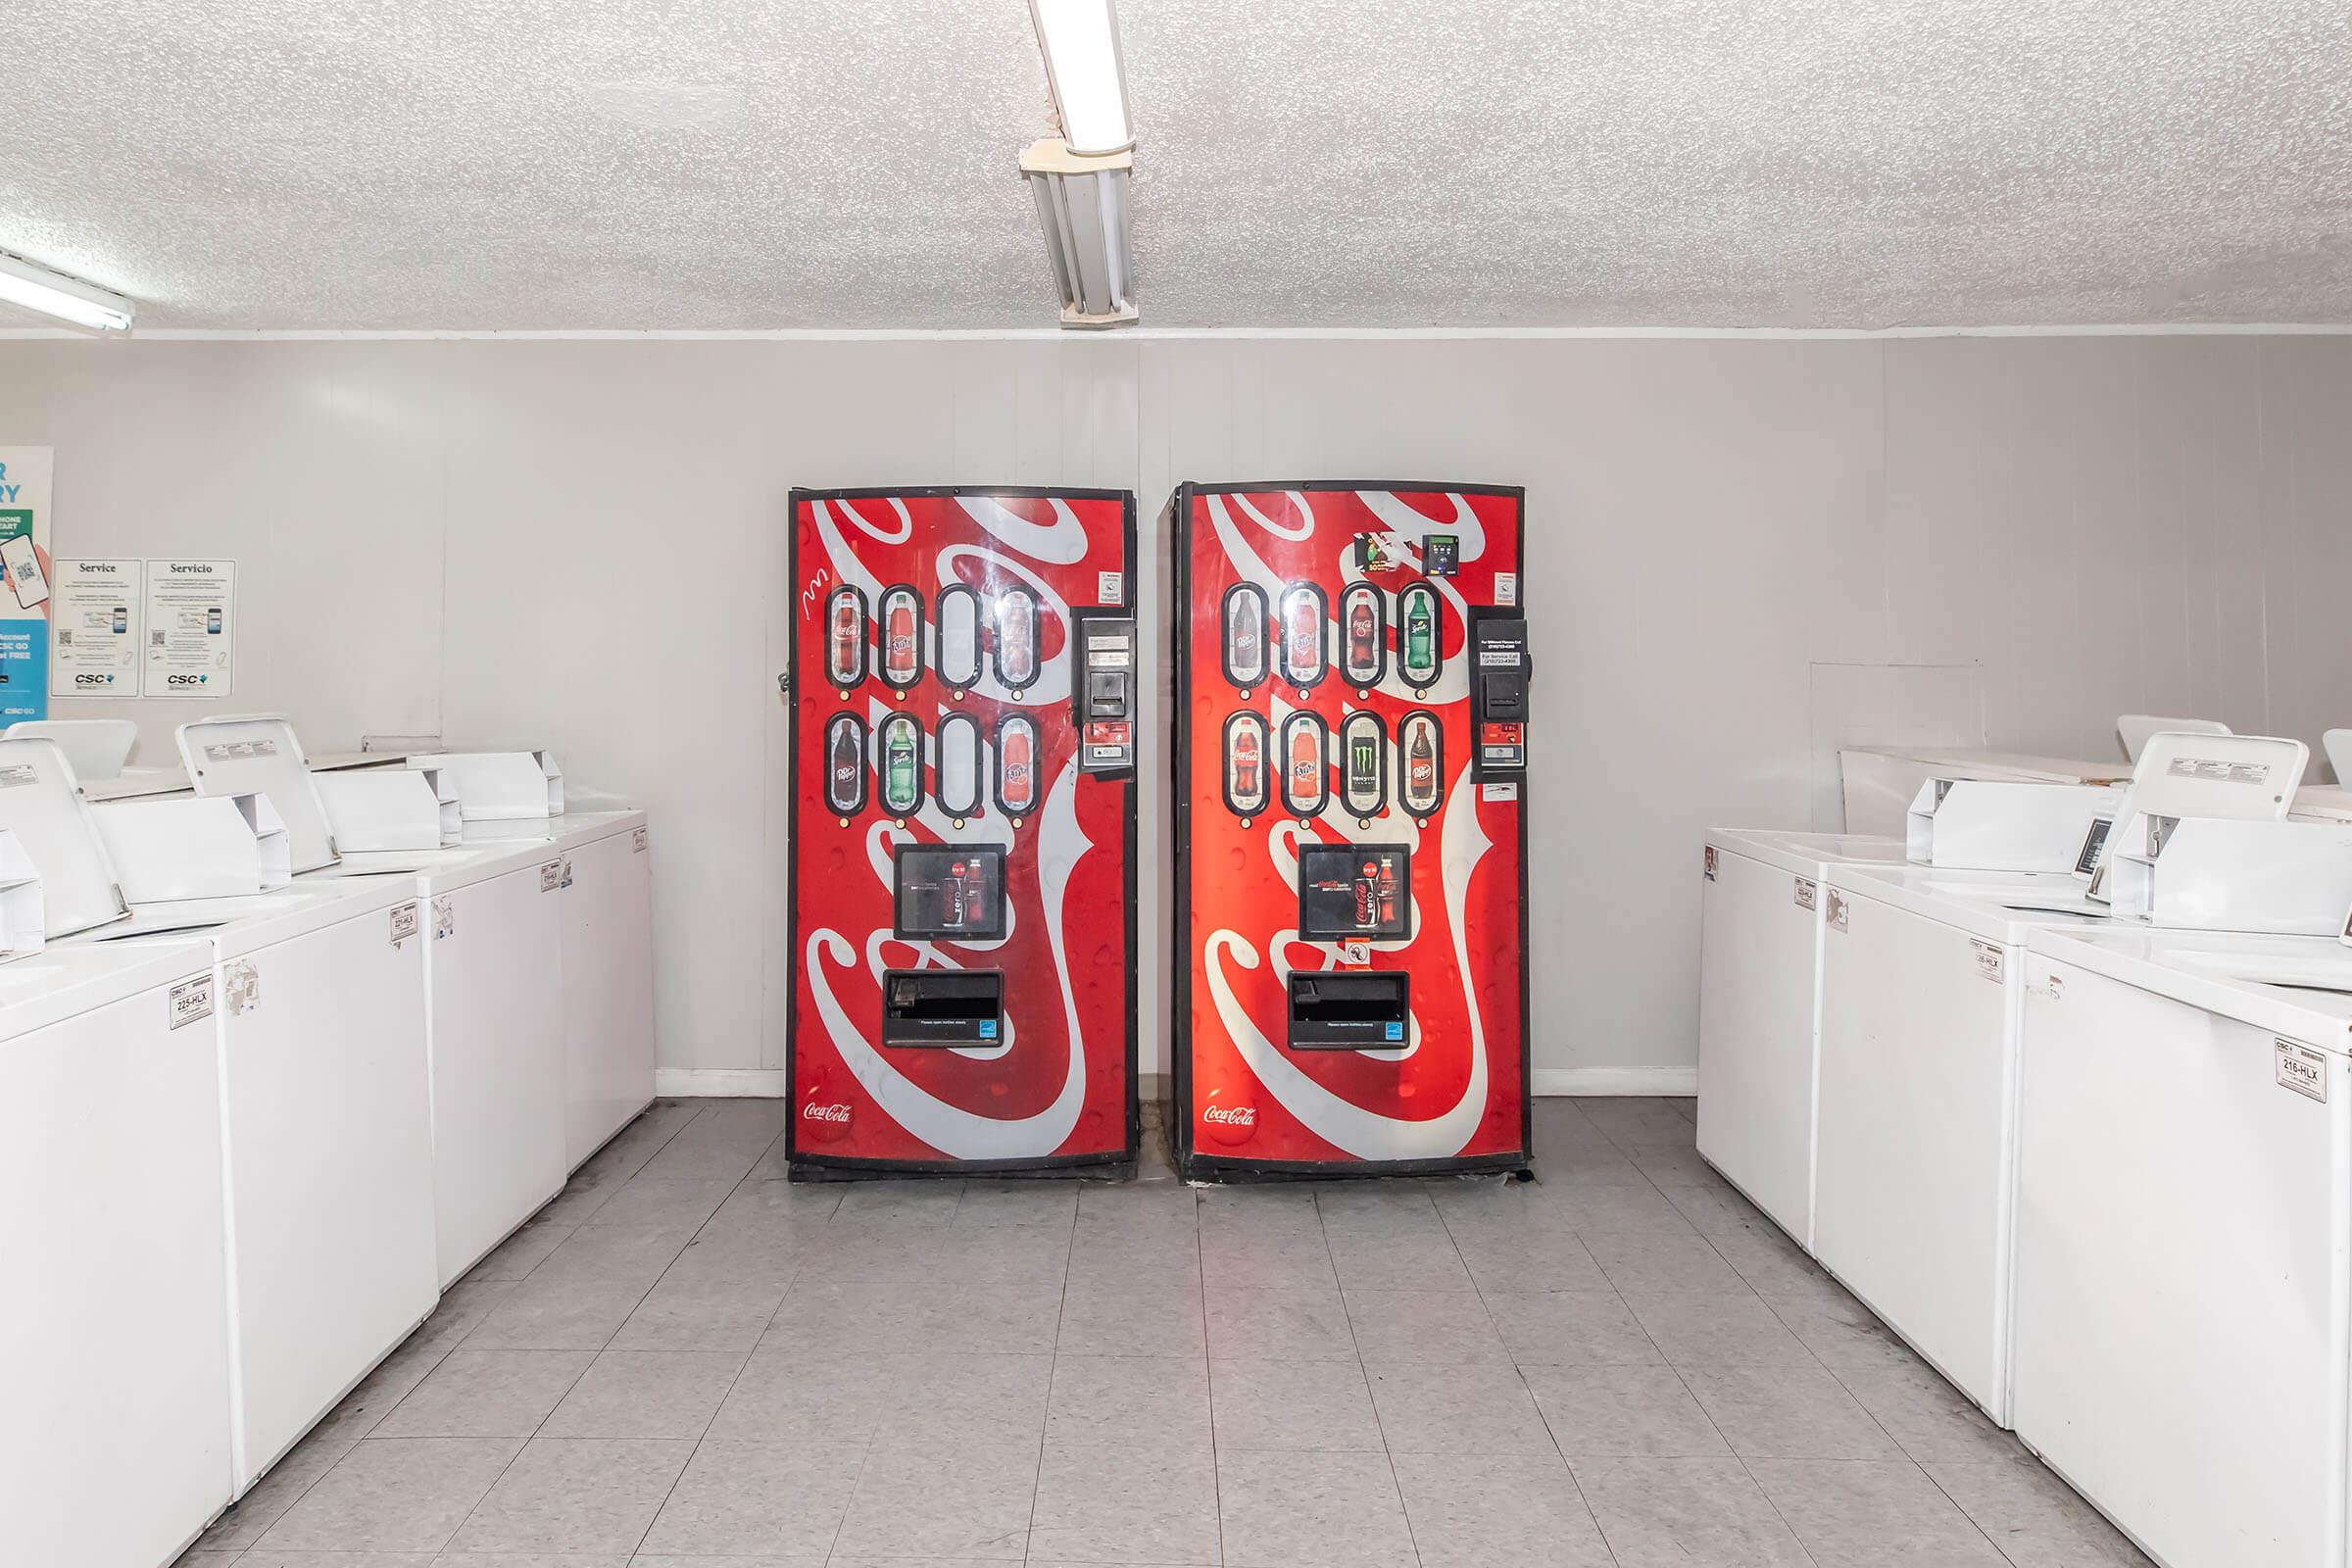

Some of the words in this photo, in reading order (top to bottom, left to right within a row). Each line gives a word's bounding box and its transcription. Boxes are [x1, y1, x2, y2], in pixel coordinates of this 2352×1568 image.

[78, 563, 117, 573] Service
[170, 564, 213, 573] Servicio
[75, 673, 105, 684] CSC
[168, 674, 198, 684] CSC
[1355, 883, 1367, 923] Coca-Cola
[177, 992, 207, 1010] 225-HLX
[2283, 1058, 2319, 1082] 216-HLX
[803, 1102, 853, 1122] Coca-Cola
[1203, 1104, 1256, 1125] Coca-Cola
